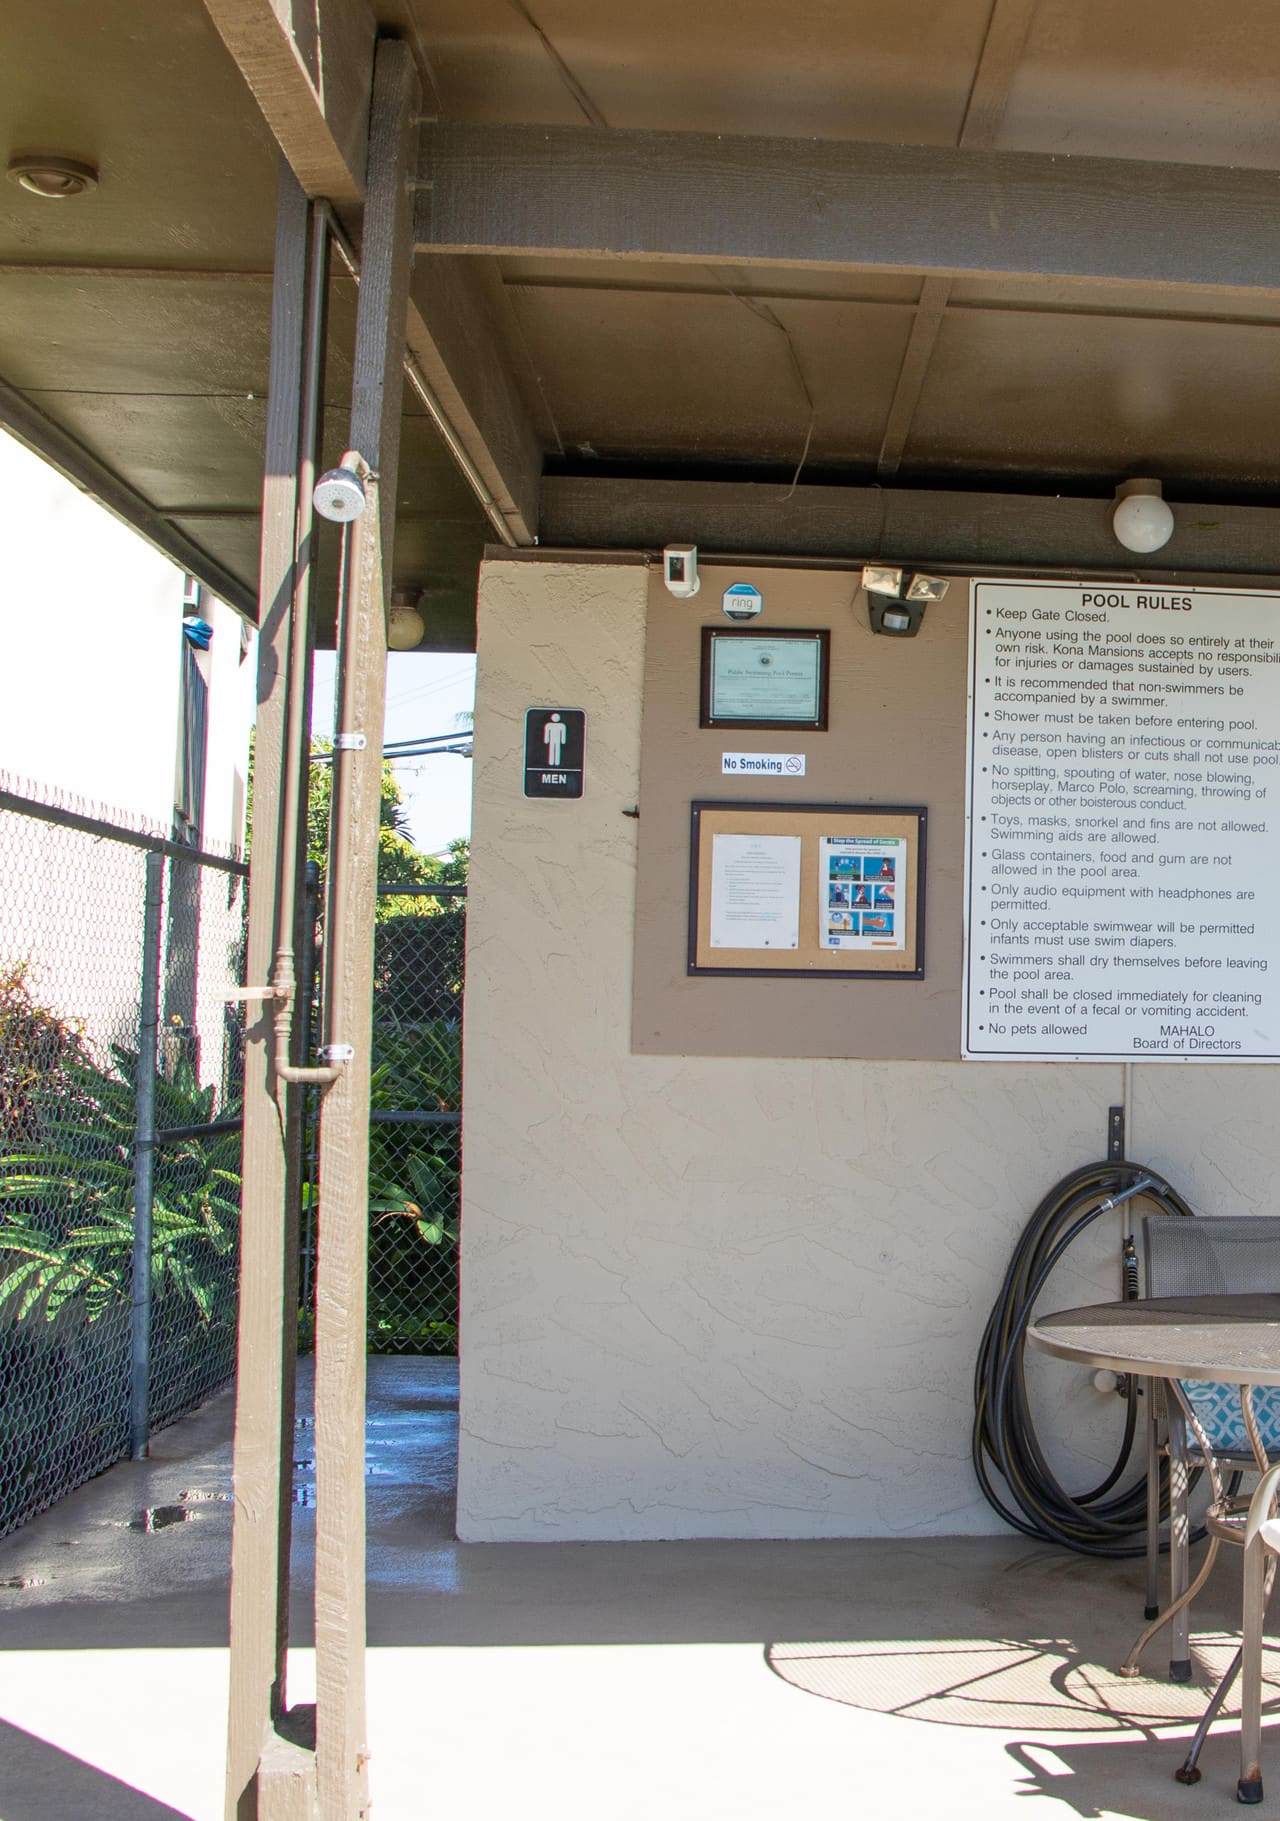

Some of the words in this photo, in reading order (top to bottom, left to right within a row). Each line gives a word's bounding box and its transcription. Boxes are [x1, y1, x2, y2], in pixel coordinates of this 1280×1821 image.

[732, 598, 752, 610] ring
[1082, 594, 1129, 609] POOL
[1137, 596, 1191, 611] RULES
[996, 607, 1026, 622] Keep
[1032, 608, 1060, 621] Gate
[1064, 609, 1108, 623] Closed.
[995, 626, 1041, 642] Anyone
[1046, 628, 1078, 644] using
[1083, 629, 1101, 642] the
[1106, 630, 1131, 646] pool
[1136, 632, 1165, 645] does
[1170, 636, 1184, 646] so
[1188, 634, 1230, 650] entirely
[1234, 636, 1244, 648] at
[1249, 636, 1274, 649] their
[995, 643, 1020, 653] own
[1025, 641, 1047, 654] risk.
[1053, 642, 1083, 656] Kona
[1088, 644, 1144, 658] Mansions
[1148, 646, 1193, 663] accepts
[1198, 651, 1212, 661] no
[995, 655, 1010, 667] for
[1015, 655, 1056, 672] injuries
[1061, 660, 1073, 670] or
[1078, 658, 1133, 675] damages
[1138, 660, 1194, 674] sustained
[1199, 663, 1213, 678] by
[1218, 666, 1251, 677] users.
[995, 674, 1001, 687] It
[1006, 675, 1015, 687] is
[1020, 675, 1107, 691] recommended
[1112, 679, 1134, 692] that
[1139, 680, 1224, 695] non-swimmers
[1229, 683, 1243, 696] be
[994, 709, 1039, 722] Shower
[1044, 711, 1073, 724] must
[1078, 712, 1093, 724] be
[1098, 712, 1130, 726] taken
[1135, 714, 1172, 727] before
[1177, 715, 1224, 732] entering
[1229, 717, 1257, 733] pool.
[724, 758, 736, 768] No
[740, 758, 782, 773] Smoking
[542, 774, 567, 784] MEN
[992, 813, 1022, 828] Toys,
[1028, 814, 1069, 828] masks,
[1075, 815, 1118, 828] snorkel
[1122, 816, 1145, 829] and
[1150, 817, 1170, 830] fins
[1174, 821, 1193, 830] are
[1198, 818, 1216, 831] not
[1221, 819, 1268, 832] allowed.
[990, 827, 1053, 844] Swimming
[1058, 829, 1083, 842] aids
[1087, 832, 1106, 842] are
[1111, 830, 1159, 844] allowed.
[991, 848, 1025, 861] Glass
[1030, 849, 1094, 864] containers,
[1100, 850, 1126, 863] food
[1131, 851, 1153, 864] and
[1158, 854, 1185, 867] gum
[1190, 855, 1208, 865] are
[1213, 853, 1231, 865] not
[991, 862, 1037, 876] allowed
[1042, 864, 1052, 876] in
[1057, 864, 1075, 876] the
[1080, 864, 1106, 880] pool
[1111, 868, 1139, 878] area.
[991, 883, 1018, 898] Only
[1023, 883, 1057, 896] audio
[1062, 884, 1125, 900] equipment
[1129, 886, 1153, 898] with
[1158, 886, 1231, 902] headphones
[1236, 891, 1254, 900] are
[991, 897, 1050, 913] permitted.
[990, 918, 1018, 933] Only
[1023, 918, 1088, 934] acceptable
[1093, 920, 1152, 933] swimwear
[1157, 921, 1174, 933] will
[1180, 921, 1194, 933] be
[1199, 922, 1254, 937] permitted
[990, 952, 1053, 966] Swimmers
[1057, 954, 1084, 966] shall
[1089, 954, 1108, 969] dry
[1113, 954, 1179, 968] themselves
[1184, 956, 1221, 968] before
[1226, 956, 1267, 972] leaving
[989, 967, 1008, 980] the
[1013, 968, 1039, 983] pool
[1044, 971, 1073, 981] area.
[989, 987, 1016, 999] Pool
[1021, 987, 1048, 1000] shall
[1053, 988, 1068, 1000] be
[1073, 988, 1112, 1001] closed
[1117, 989, 1188, 1004] immediately
[1193, 990, 1208, 1002] for
[1212, 990, 1261, 1006] cleaning
[989, 1002, 998, 1014] in
[1004, 1002, 1022, 1014] the
[1027, 1002, 1059, 1014] event
[1064, 1003, 1075, 1015] of
[1080, 1006, 1087, 1015] a
[1092, 1003, 1120, 1015] fecal
[1124, 1006, 1136, 1016] or
[1141, 1004, 1190, 1019] vomiting
[1196, 1004, 1248, 1017] accident.
[988, 1022, 1006, 1034] No
[1011, 1022, 1036, 1037] pets
[1041, 1023, 1086, 1035] allowed
[1160, 1024, 1214, 1037] MAHALO
[1133, 1037, 1168, 1049] Board
[1173, 1037, 1184, 1049] of
[1189, 1037, 1241, 1050] Directors
